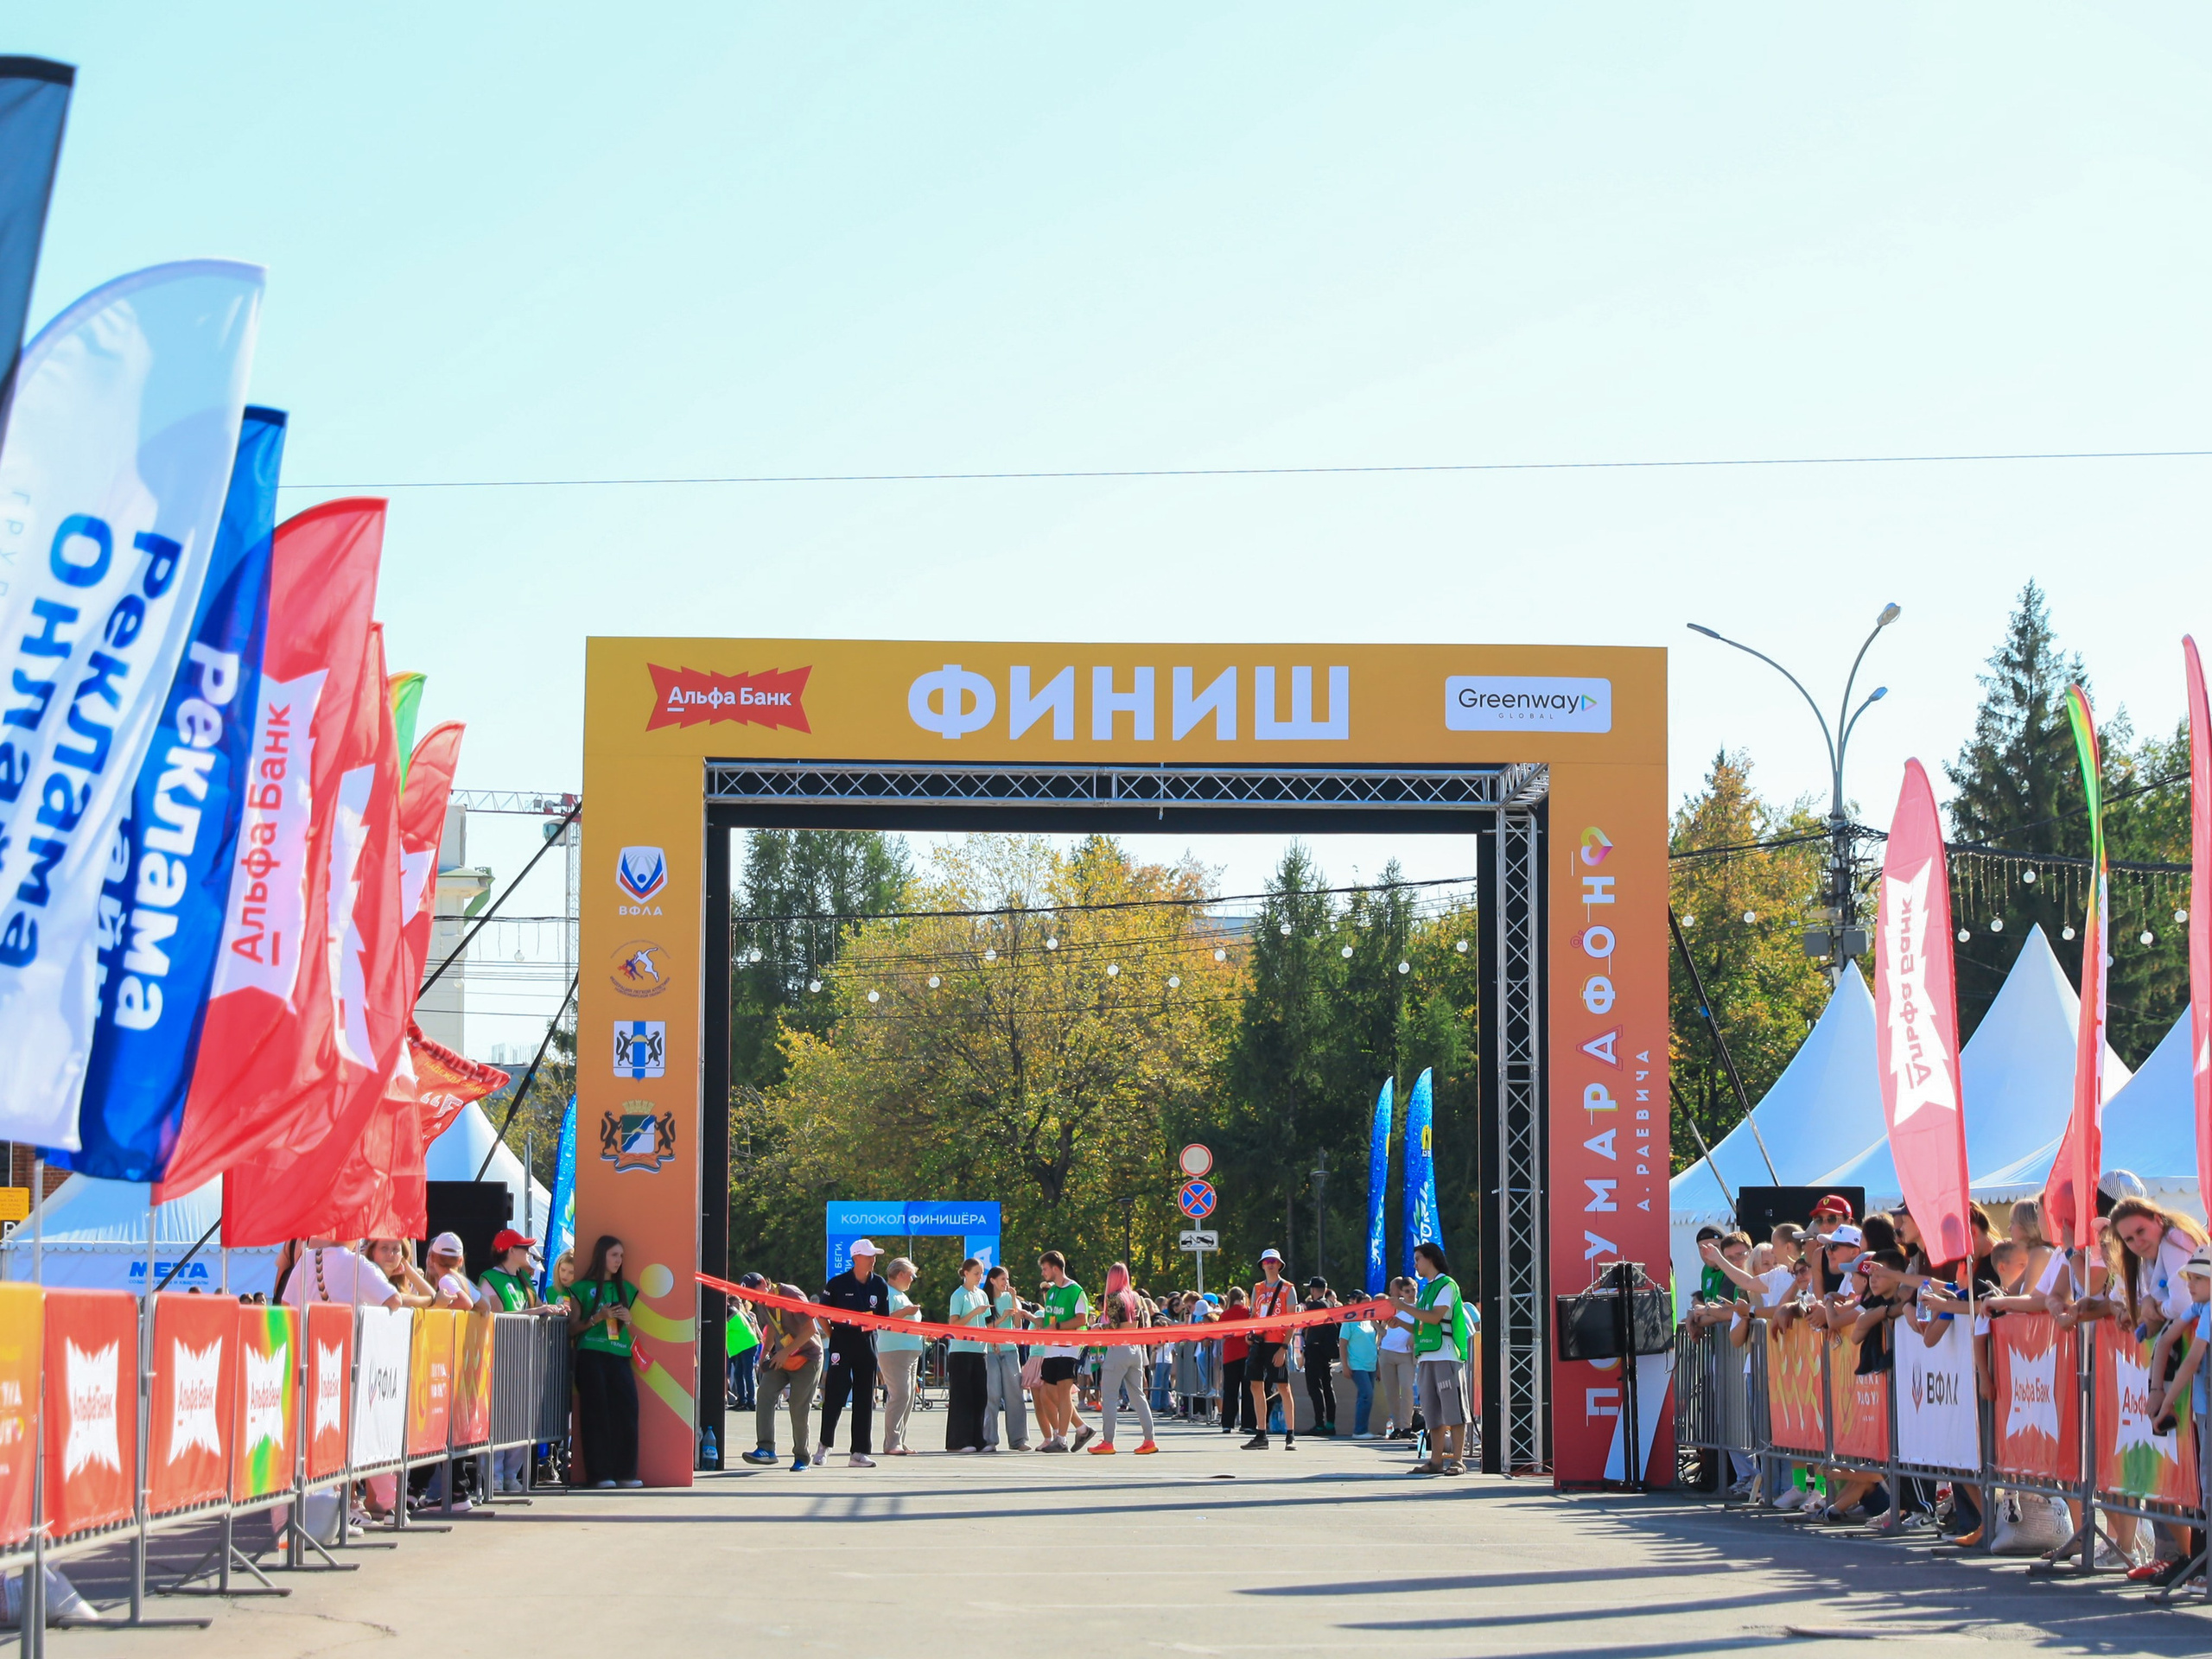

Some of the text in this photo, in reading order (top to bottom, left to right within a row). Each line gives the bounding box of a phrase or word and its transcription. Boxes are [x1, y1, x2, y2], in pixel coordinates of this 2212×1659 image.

[666, 685, 792, 710] Альфа Банк
[907, 664, 1351, 741] ФИНИШ
[1458, 688, 1580, 715] Greenway
[0, 529, 183, 969] Реклама
[112, 641, 240, 1032] Реклама
[230, 701, 291, 967] Альфа Банк
[618, 905, 664, 916] ВФЛА
[1636, 1050, 1650, 1212] А. РАЕВИЧА
[841, 1211, 988, 1225] КОЛОКОЛ ФИНИШЁРА
[834, 1241, 844, 1269] БЕГИ,
[129, 1261, 209, 1279] МЕТА
[2014, 1377, 2036, 1408] Альфа
